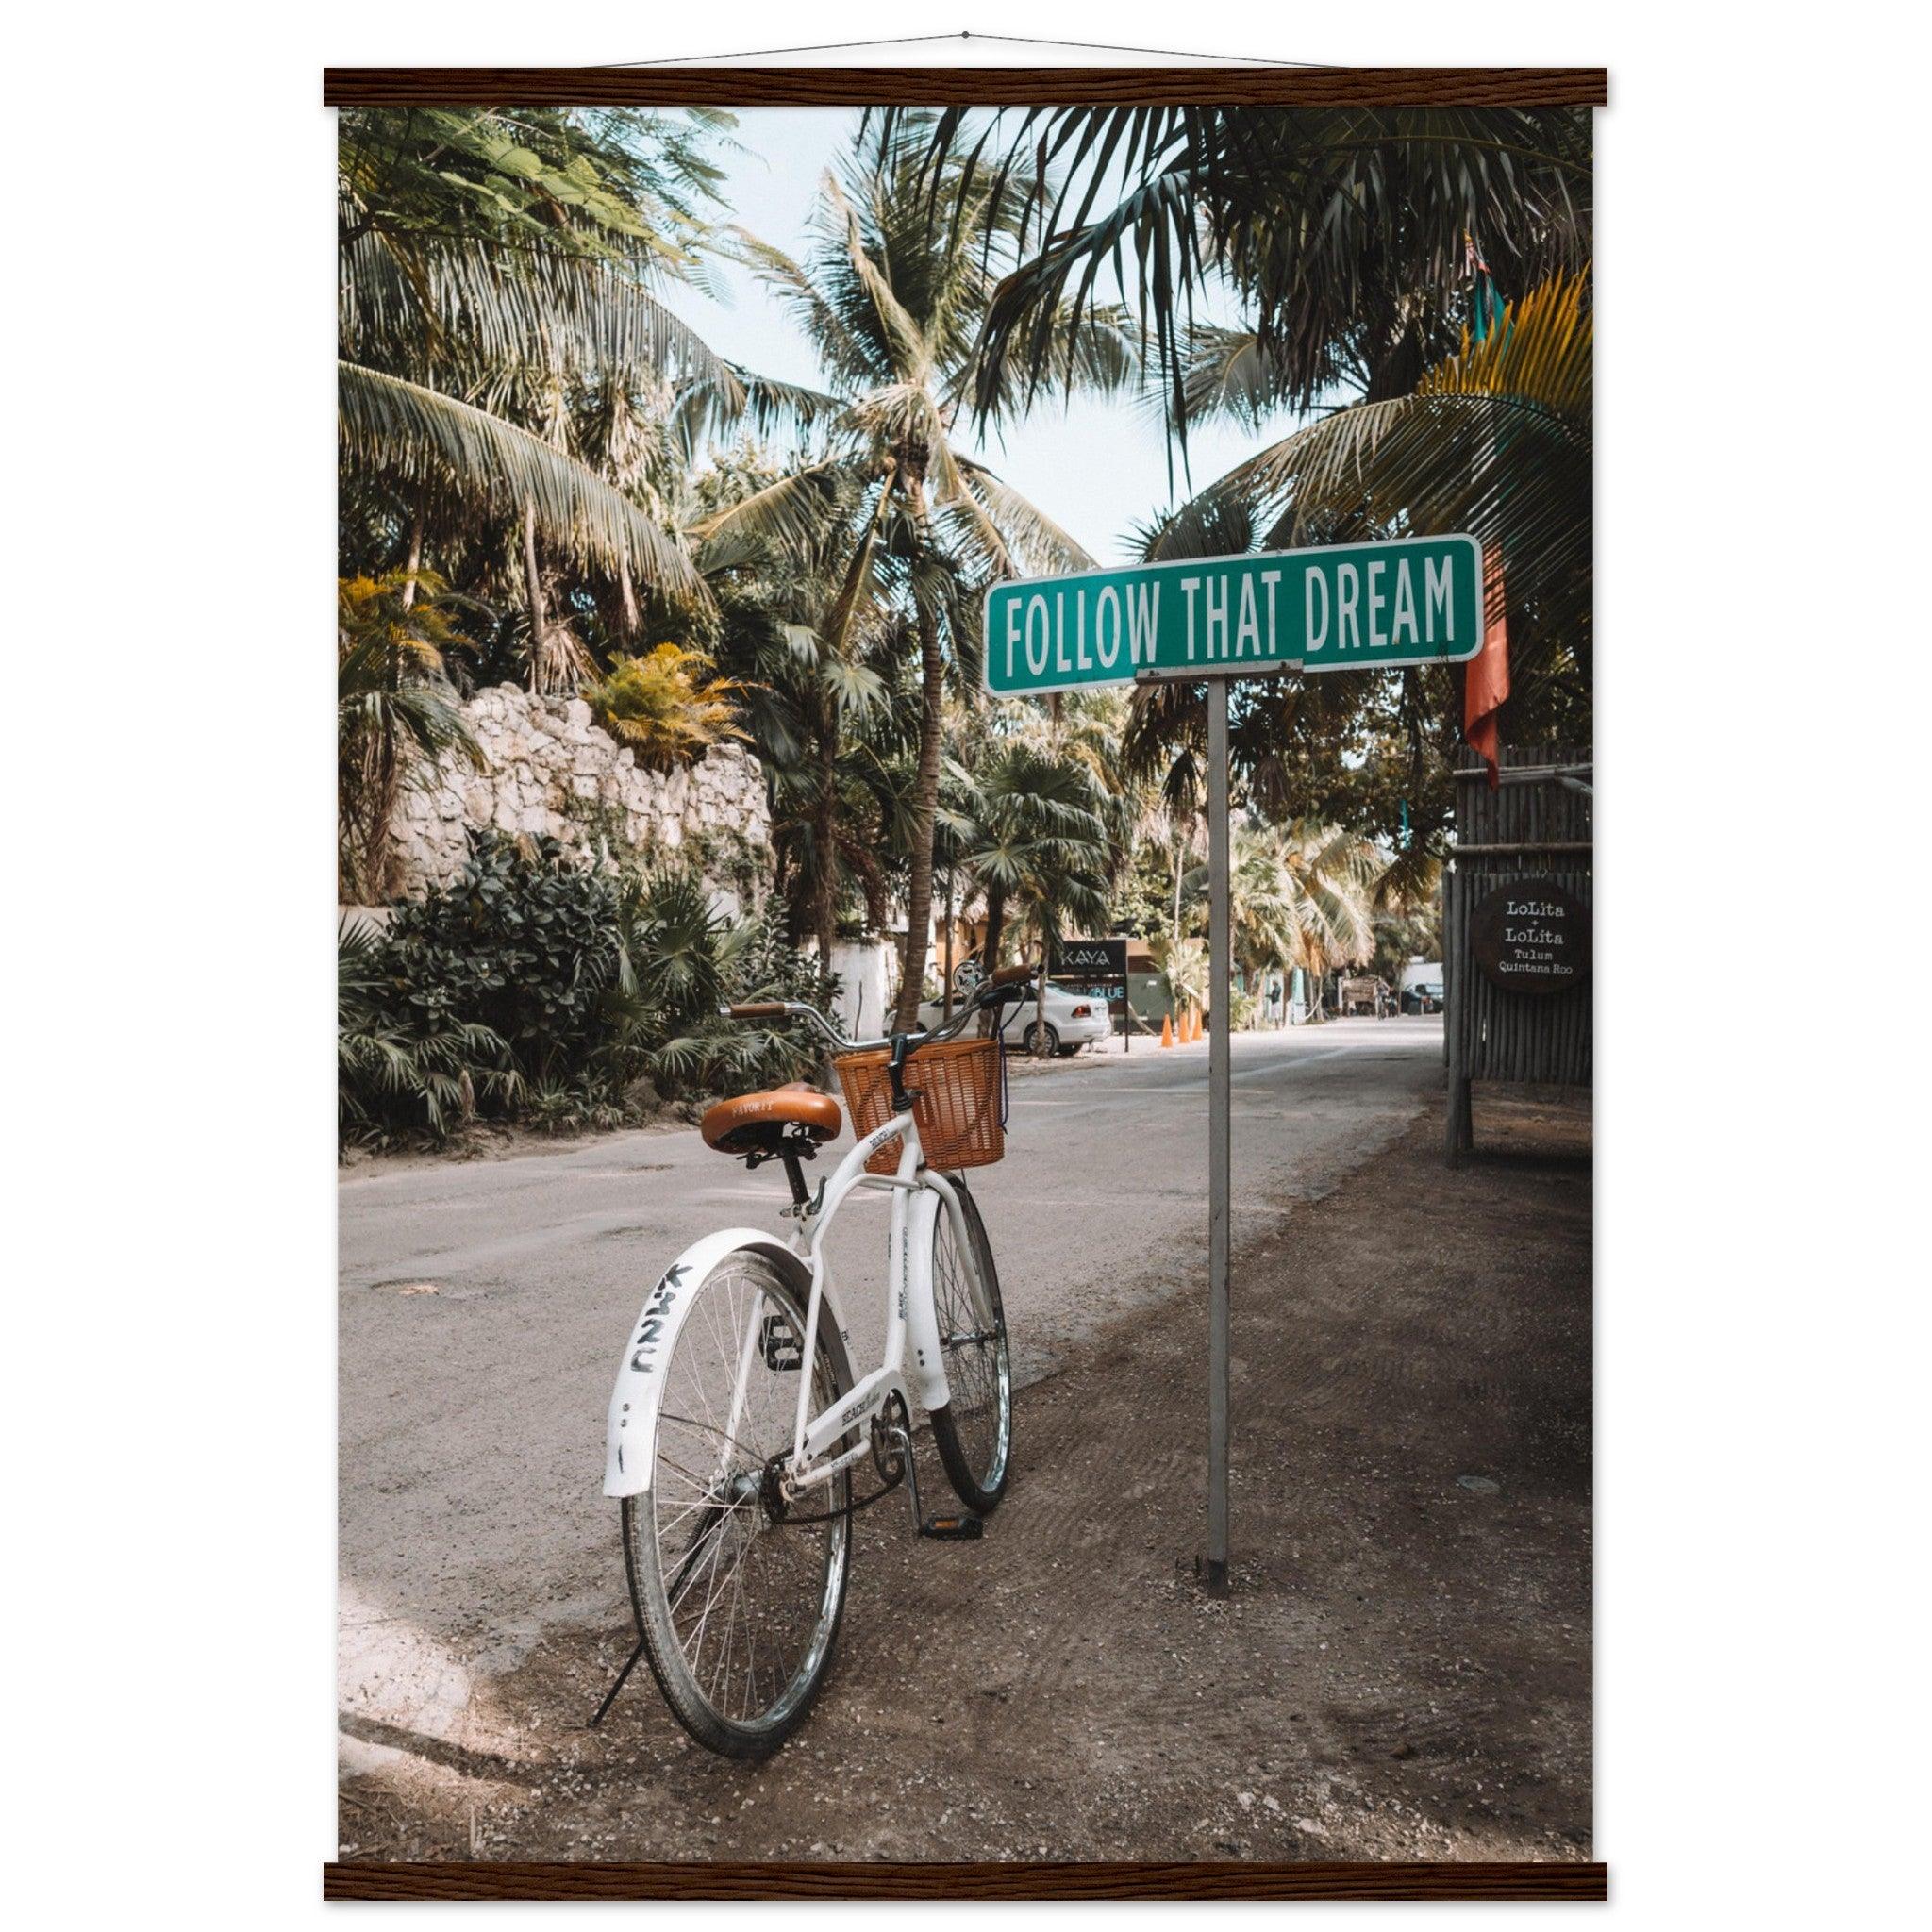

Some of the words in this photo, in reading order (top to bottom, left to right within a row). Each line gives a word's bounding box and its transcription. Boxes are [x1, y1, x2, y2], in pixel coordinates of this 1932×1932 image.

[1005, 580, 1160, 677] FOLLOW
[1180, 570, 1282, 659] THAT
[1304, 554, 1455, 651] DREAM
[1506, 901, 1565, 917] LoLita
[1505, 928, 1564, 944] LoLita
[1059, 949, 1110, 966] KAYA
[1514, 949, 1553, 960] Tulum
[1499, 961, 1550, 973] Quintana
[1553, 964, 1574, 974] Roo
